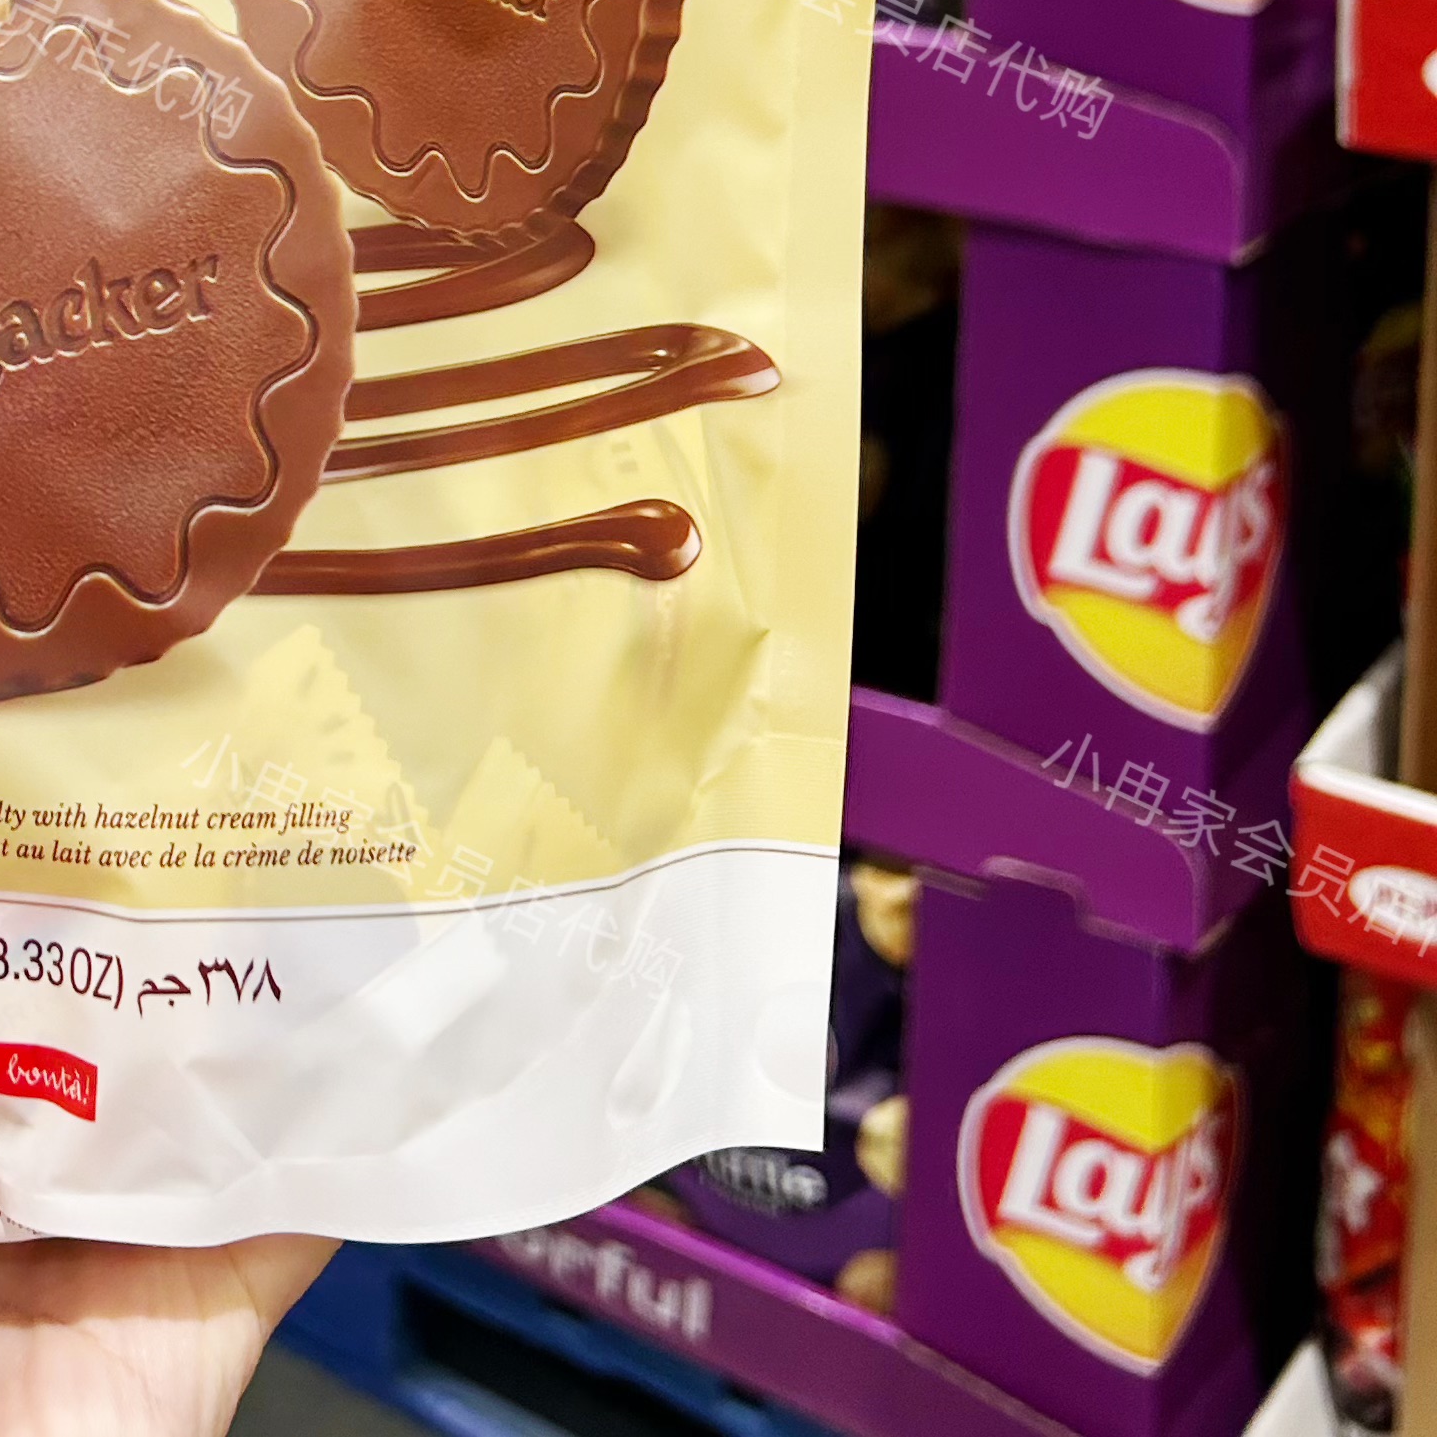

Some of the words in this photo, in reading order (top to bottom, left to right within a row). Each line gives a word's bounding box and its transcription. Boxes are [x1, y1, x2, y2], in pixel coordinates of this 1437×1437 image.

[32, 802, 87, 829] with
[95, 802, 200, 830] hazelnut
[206, 807, 277, 831] cream
[277, 802, 354, 836] filling
[16, 842, 45, 861] au
[52, 839, 92, 865] lait
[99, 847, 152, 869] avec
[159, 842, 187, 868] de
[193, 842, 217, 868] la
[222, 841, 290, 869] crème
[297, 839, 324, 866] de
[330, 836, 417, 865] noisette
